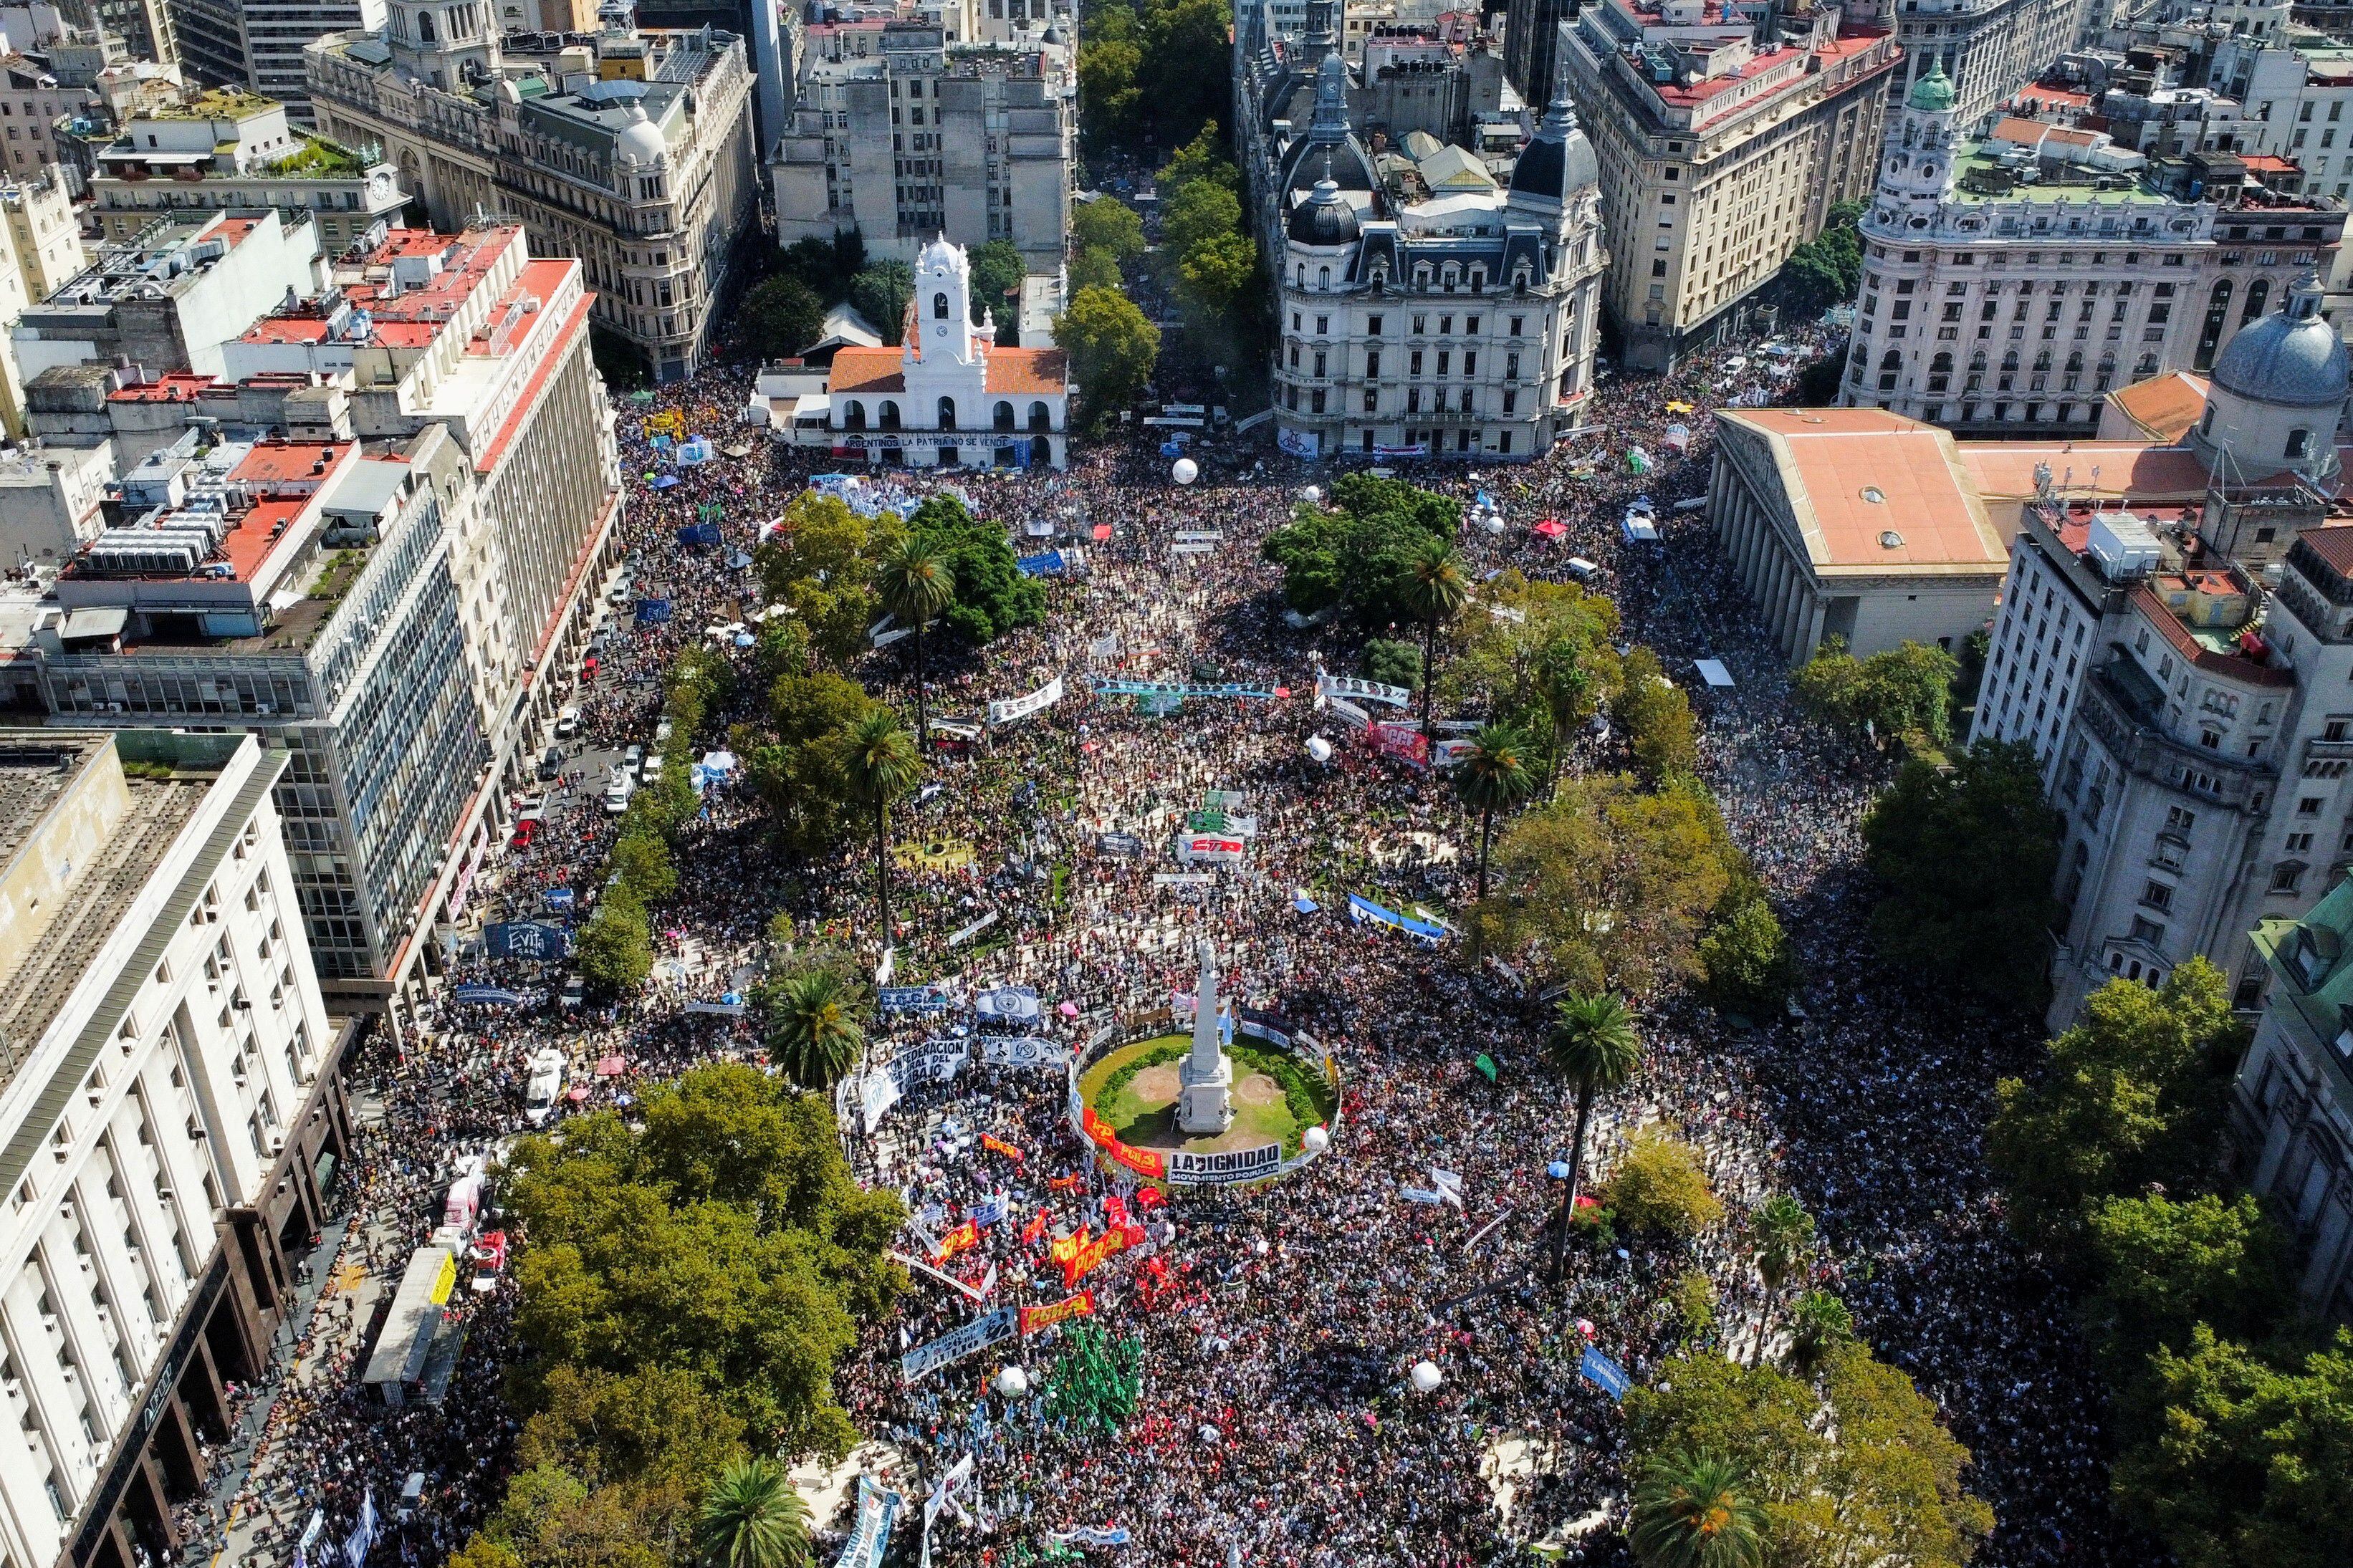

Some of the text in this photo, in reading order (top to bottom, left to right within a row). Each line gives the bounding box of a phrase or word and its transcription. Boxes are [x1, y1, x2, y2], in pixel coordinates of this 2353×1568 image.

[902, 438, 913, 447] LA
[916, 438, 949, 447] PATRIA
[965, 438, 977, 446] SE
[980, 438, 1008, 447] VENDE
[517, 948, 540, 957] CABA
[886, 1042, 964, 1074] CONFEDERACION
[932, 1054, 951, 1064] DEL
[1120, 1145, 1143, 1163] PCR
[1172, 1154, 1194, 1171] LA
[1196, 1145, 1278, 1172] DIGNIDAD
[1171, 1164, 1279, 1182] MOVIMIENTO POPULAR
[1052, 1237, 1078, 1264] PCR
[1075, 1241, 1105, 1280] PCR
[1028, 1302, 1065, 1327] PCR
[930, 1322, 982, 1349] PERONISMO
[944, 1338, 962, 1351] 26
[144, 1362, 172, 1431] AFIP
